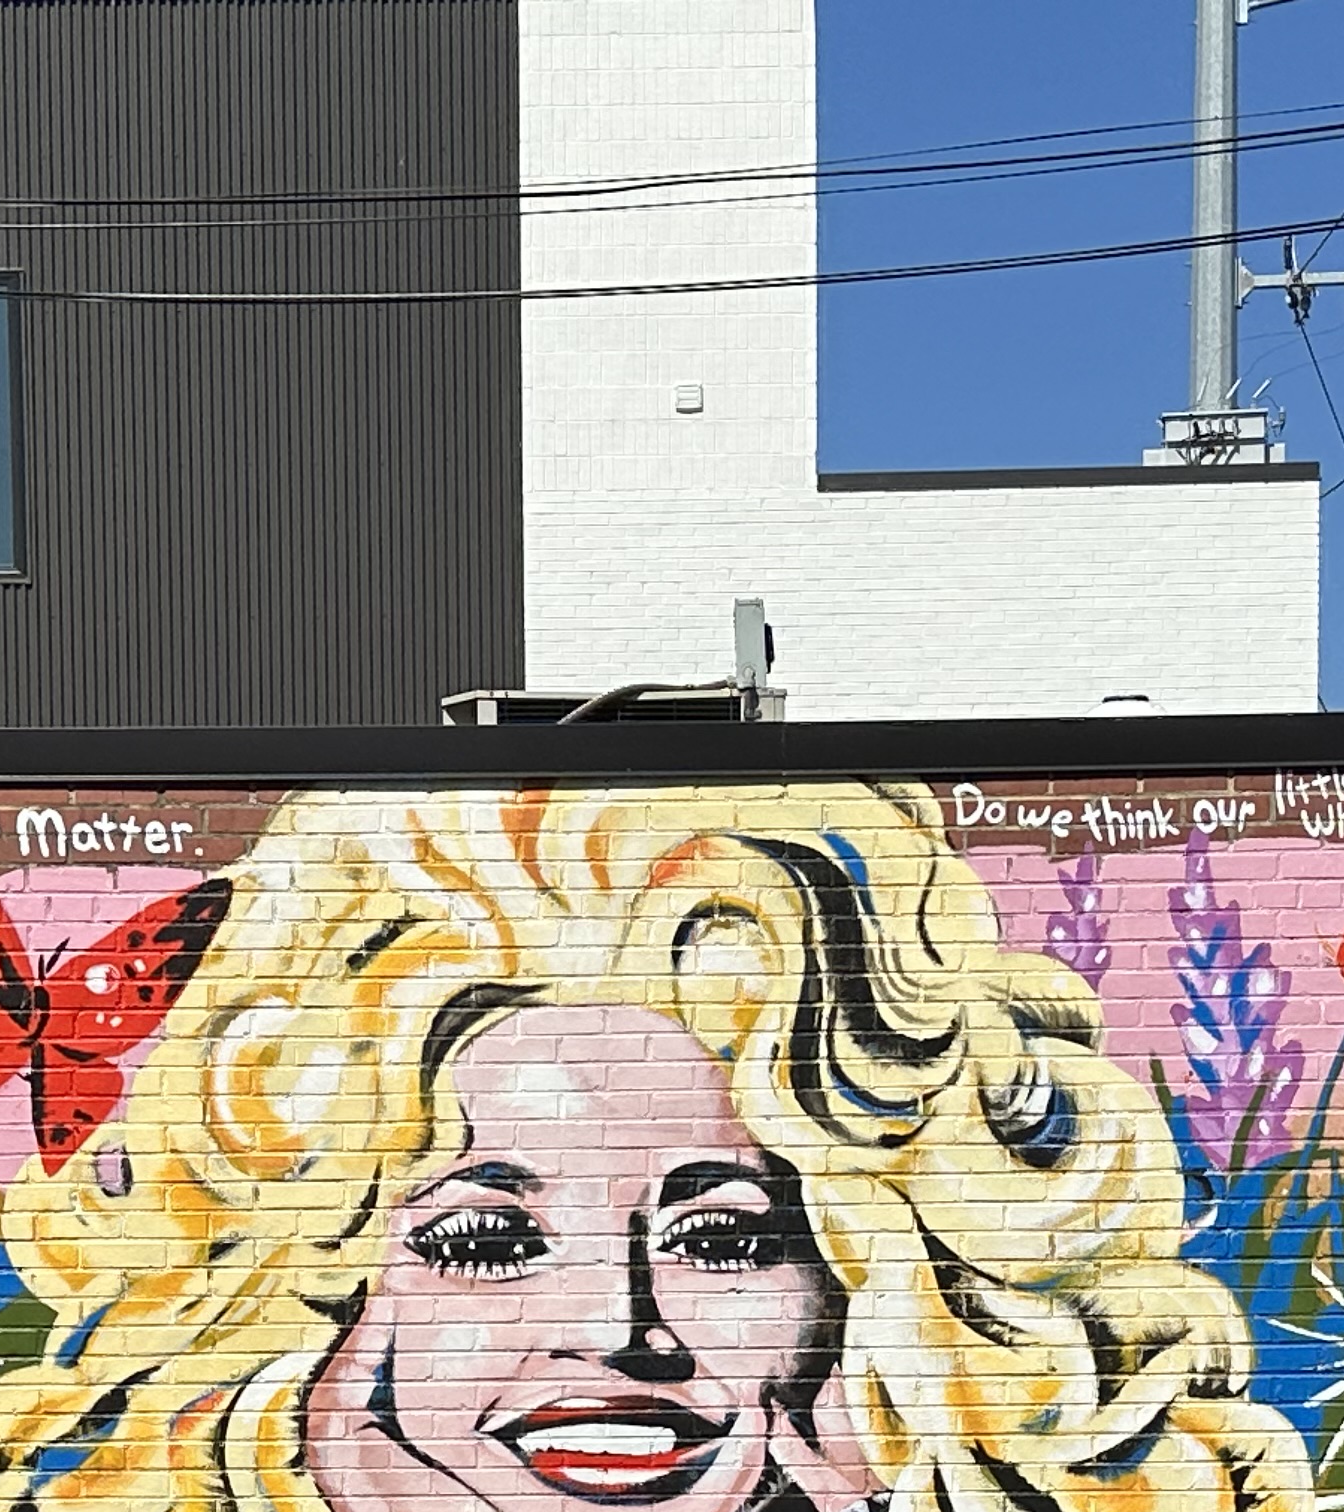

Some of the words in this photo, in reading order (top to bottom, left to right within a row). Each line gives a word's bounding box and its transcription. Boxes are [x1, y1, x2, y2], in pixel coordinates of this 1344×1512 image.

[953, 783, 1006, 826] Do
[1017, 803, 1072, 838] we
[1082, 796, 1180, 845] think
[1194, 799, 1256, 833] our
